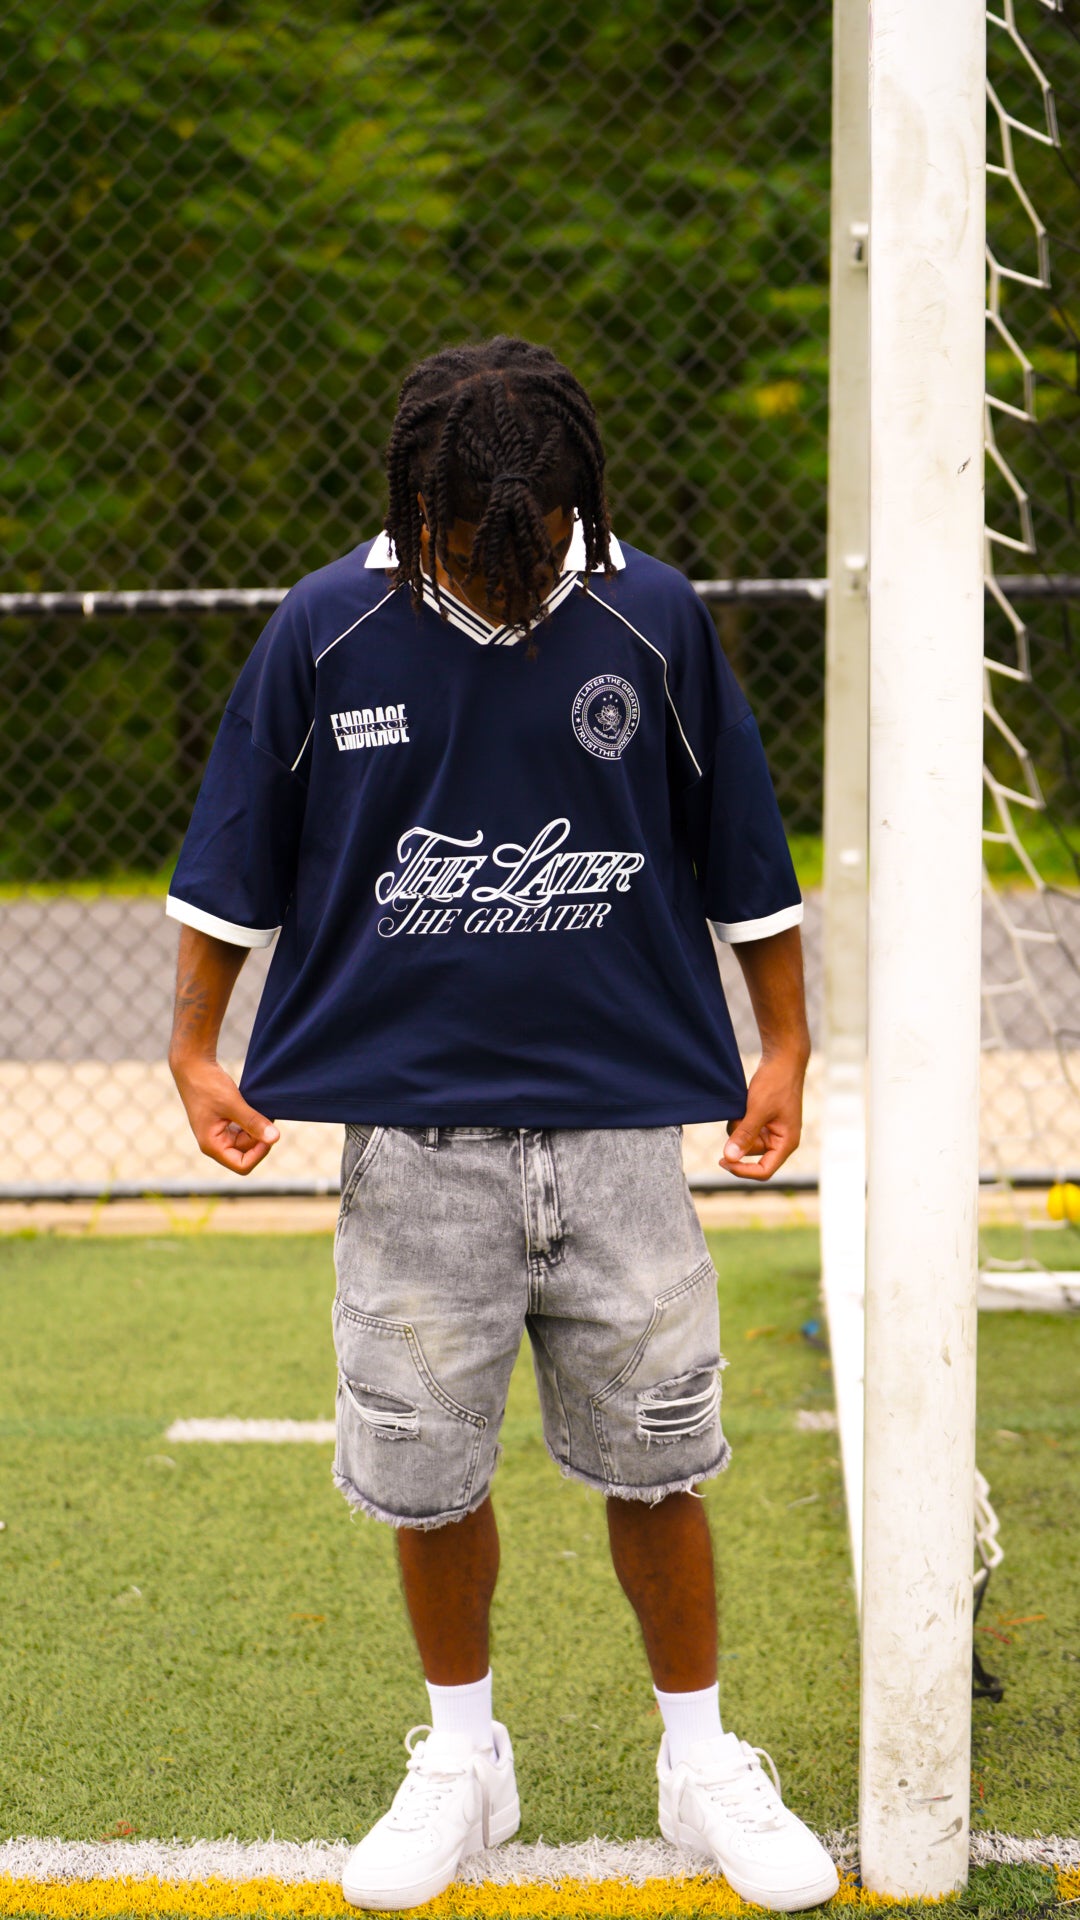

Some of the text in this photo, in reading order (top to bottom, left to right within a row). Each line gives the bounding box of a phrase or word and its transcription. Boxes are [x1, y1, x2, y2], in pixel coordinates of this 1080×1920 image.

[574, 676, 638, 720] THE LATER THE GREATER
[330, 703, 410, 752] EMBRACE
[599, 748, 616, 757] THE
[617, 727, 634, 757] JNEY
[375, 817, 645, 908] THE LATER
[377, 892, 612, 938] THE GREATER
